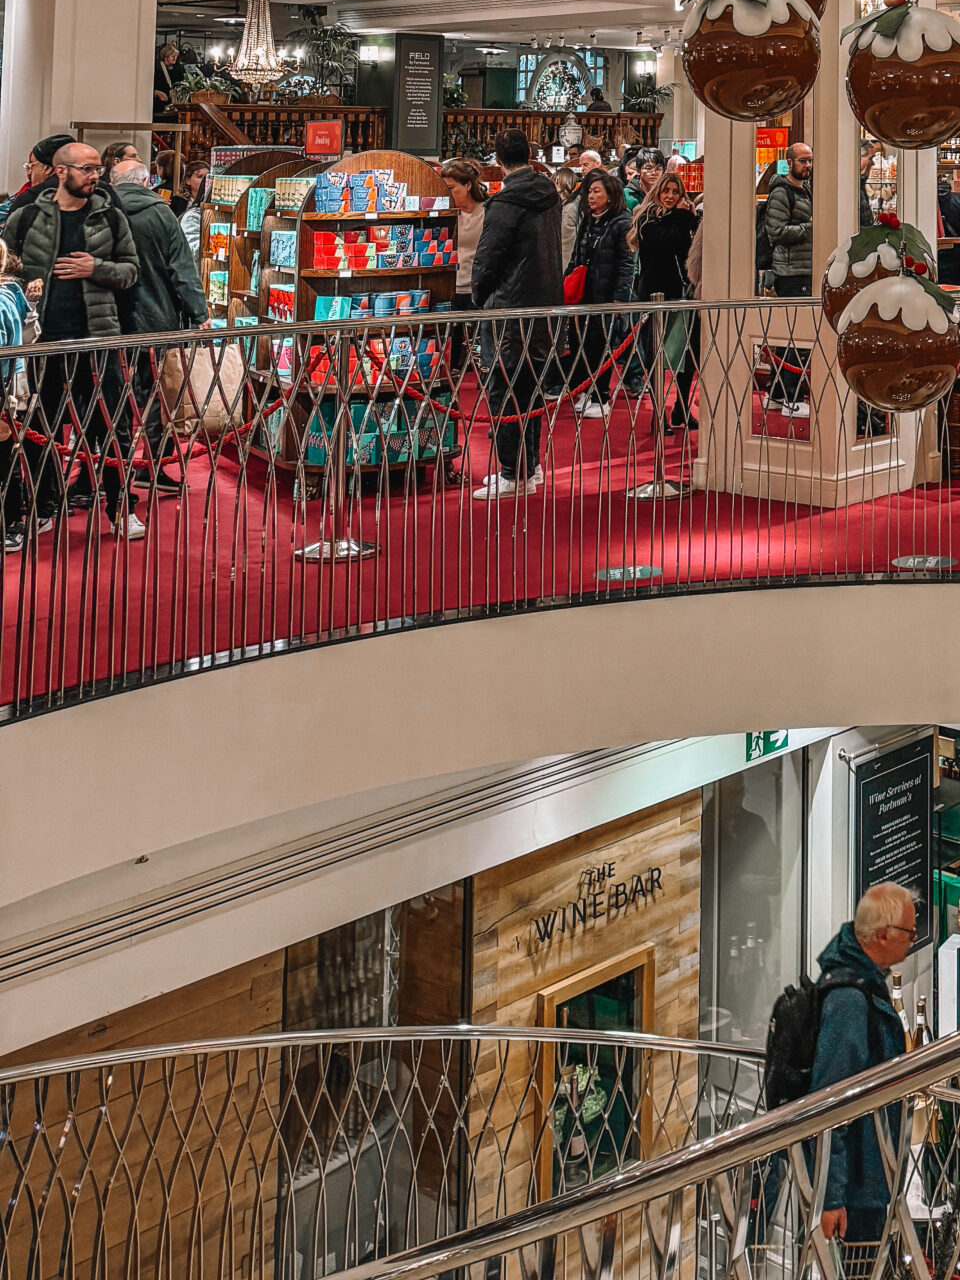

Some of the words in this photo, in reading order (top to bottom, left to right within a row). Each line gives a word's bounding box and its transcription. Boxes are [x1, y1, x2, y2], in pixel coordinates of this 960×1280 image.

[869, 791, 886, 806] Wine
[886, 781, 914, 798] Services
[878, 792, 913, 815] Fortnum's
[585, 861, 617, 888] THE
